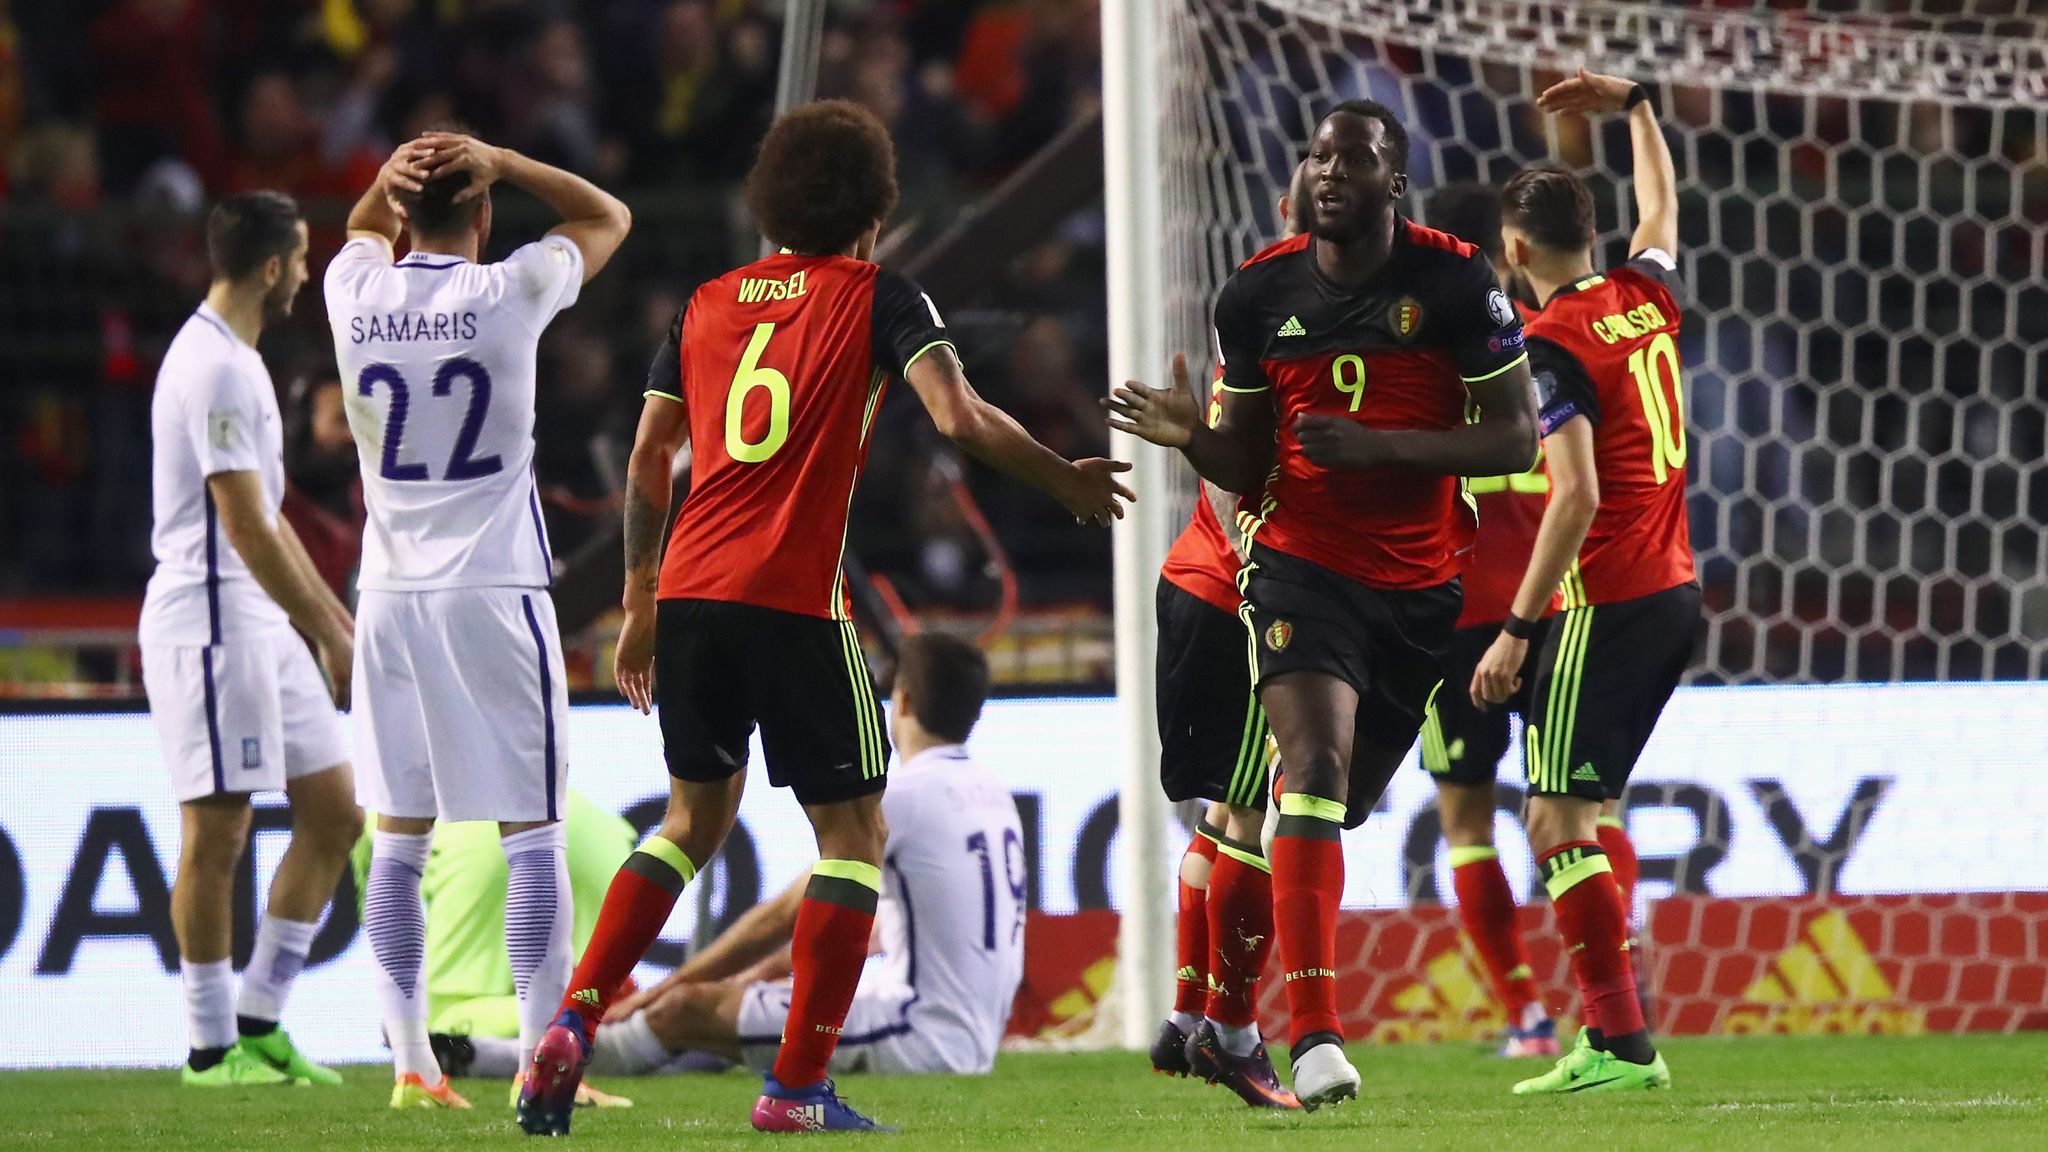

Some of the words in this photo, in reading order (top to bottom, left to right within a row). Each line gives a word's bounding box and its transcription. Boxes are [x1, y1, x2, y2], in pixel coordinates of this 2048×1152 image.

[737, 270, 808, 303] WITSEL
[351, 312, 477, 344] SAMARIS
[1277, 328, 1306, 337] adidas
[1592, 302, 1667, 344] CASCO
[725, 322, 791, 463] 6
[1332, 354, 1366, 412] 9
[358, 358, 503, 481] 22
[1628, 332, 1687, 485] 10
[966, 827, 1028, 950] 19
[1285, 968, 1336, 982] BELGIUM
